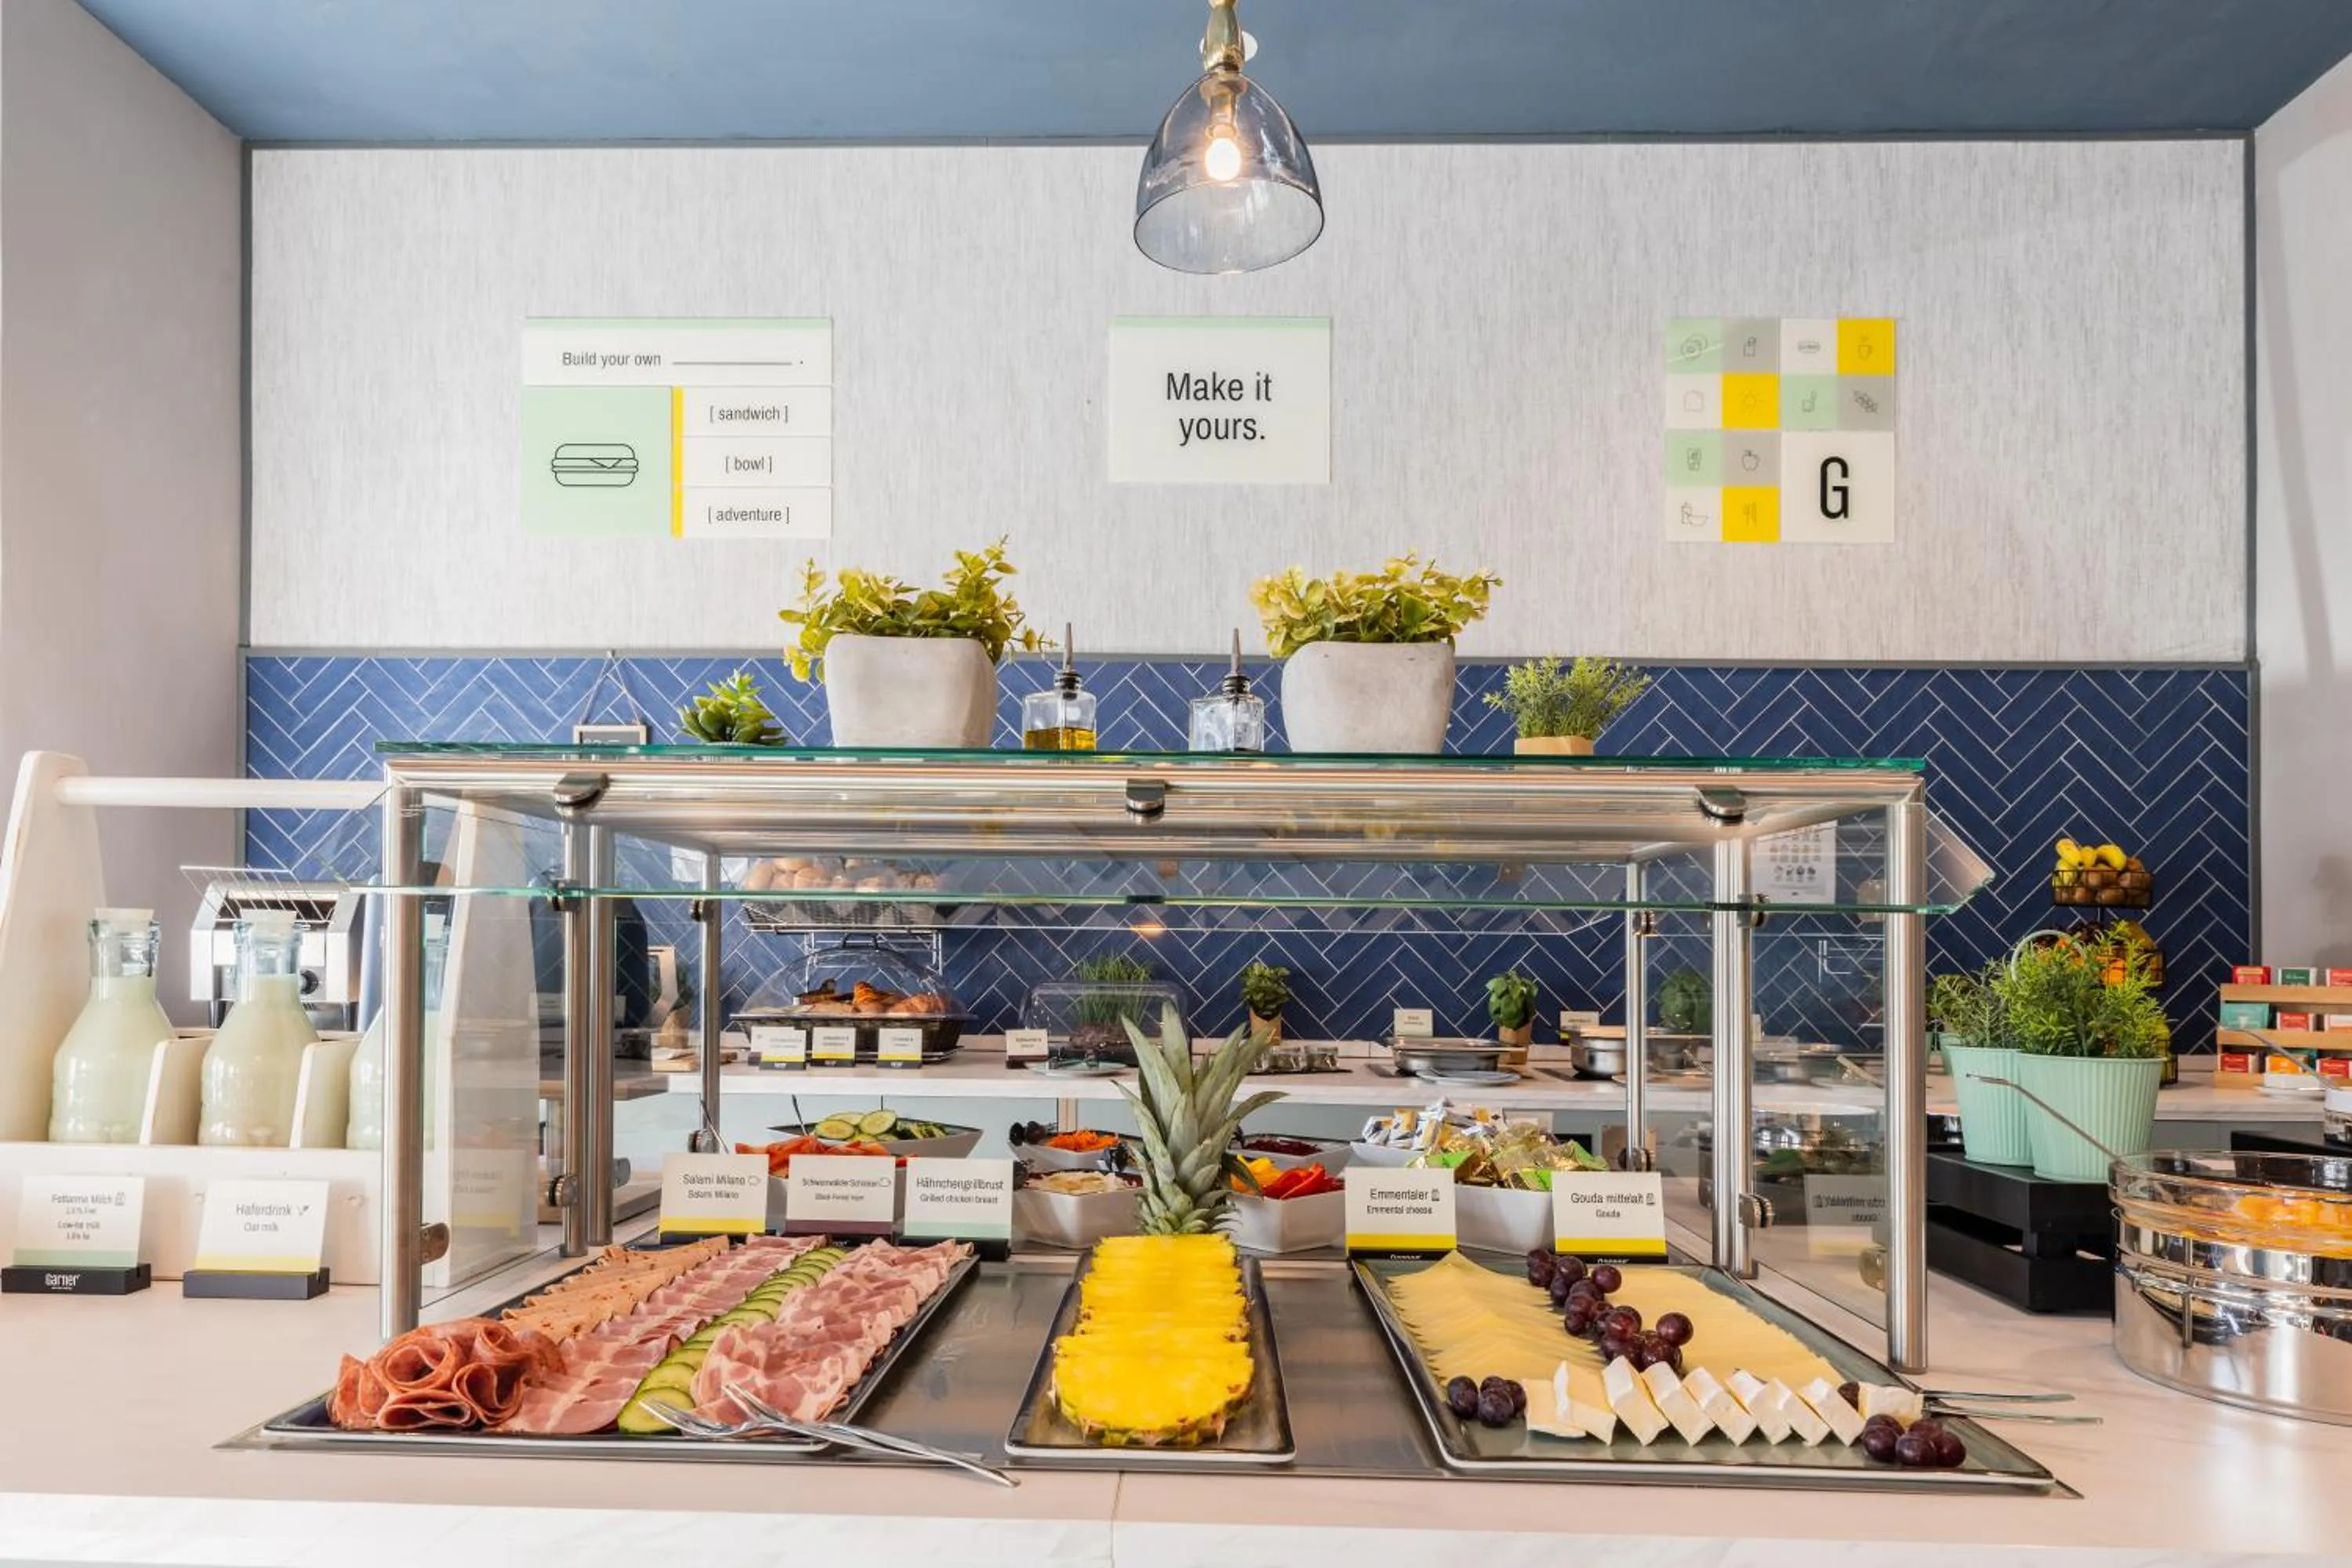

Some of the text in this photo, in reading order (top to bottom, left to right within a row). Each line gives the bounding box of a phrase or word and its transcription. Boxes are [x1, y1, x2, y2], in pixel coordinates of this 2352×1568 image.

[561, 350, 597, 366] Build
[600, 354, 631, 369] your
[633, 354, 662, 367] own
[1167, 371, 1273, 402] Make it
[717, 405, 781, 422] sandwich
[1178, 416, 1266, 448] yours.
[733, 456, 765, 472] bowl
[1820, 456, 1849, 519] G
[716, 507, 783, 522] adventure
[683, 1174, 746, 1186] Salami Milano
[1370, 1188, 1429, 1200] Emmentaler
[1570, 1192, 1604, 1204] Gouda
